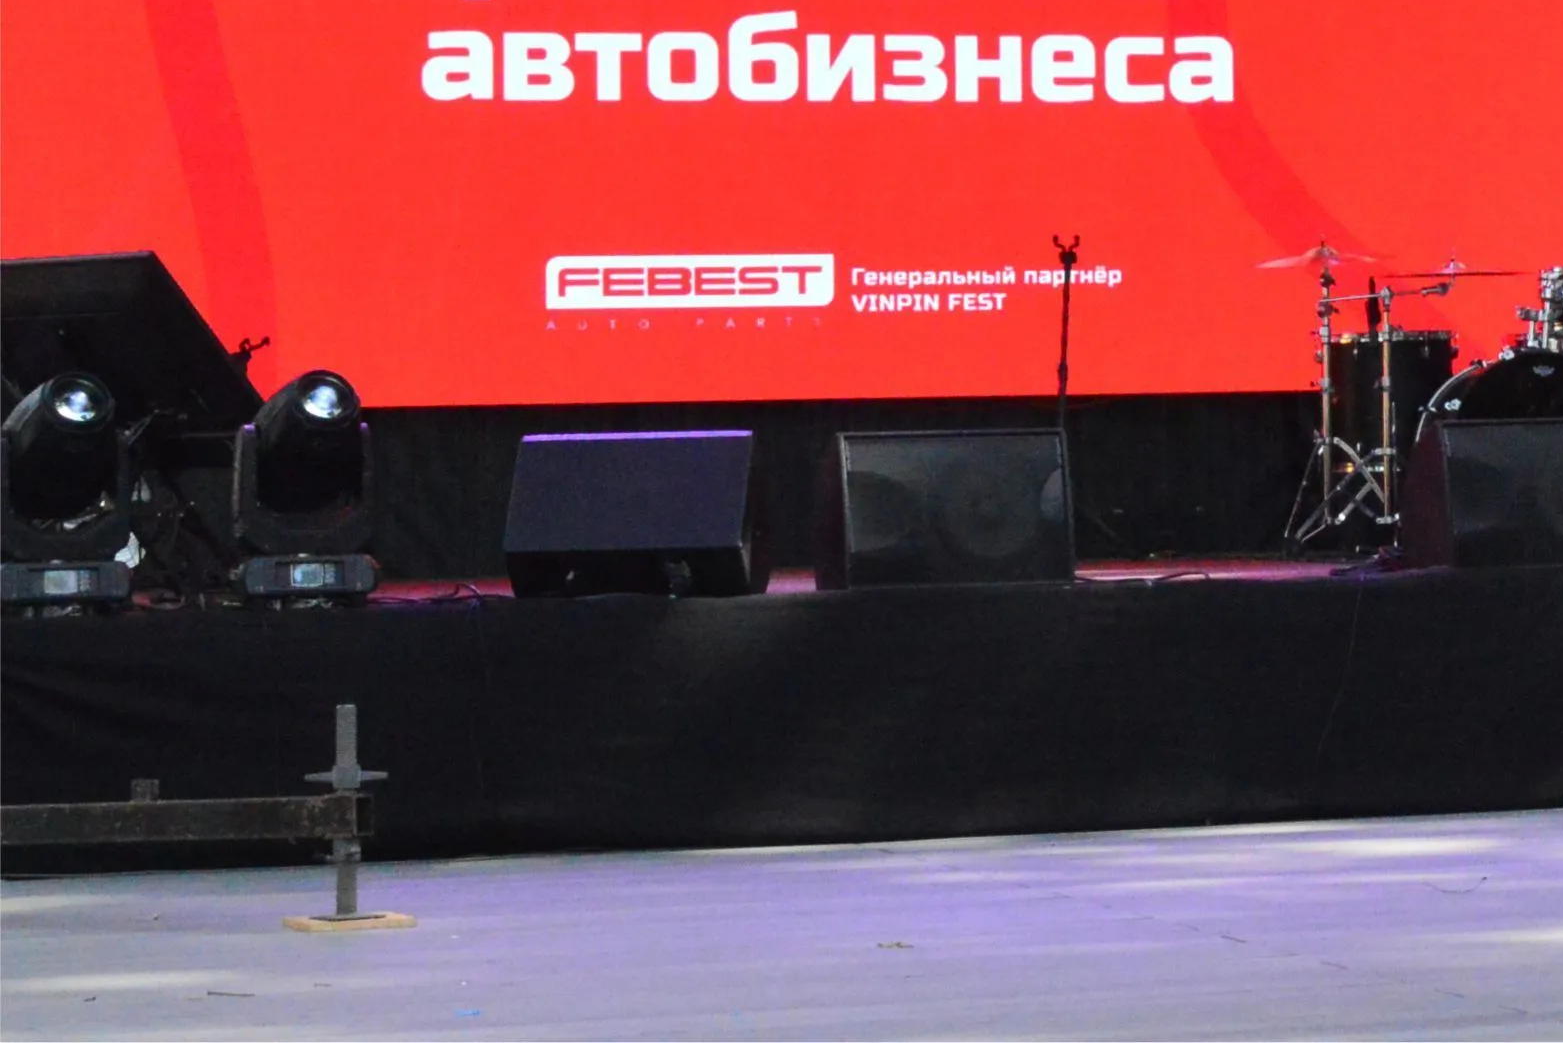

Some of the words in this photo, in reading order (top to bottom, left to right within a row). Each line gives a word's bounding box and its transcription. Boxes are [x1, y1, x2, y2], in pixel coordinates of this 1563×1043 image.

[421, 10, 1235, 103] автобизнеса
[557, 265, 823, 297] FEBEST
[851, 266, 1016, 289] Генеральный
[1023, 266, 1122, 288] партнёр
[851, 293, 940, 312] VINPIN
[948, 292, 1007, 311] FEST
[546, 318, 650, 331] AUTO
